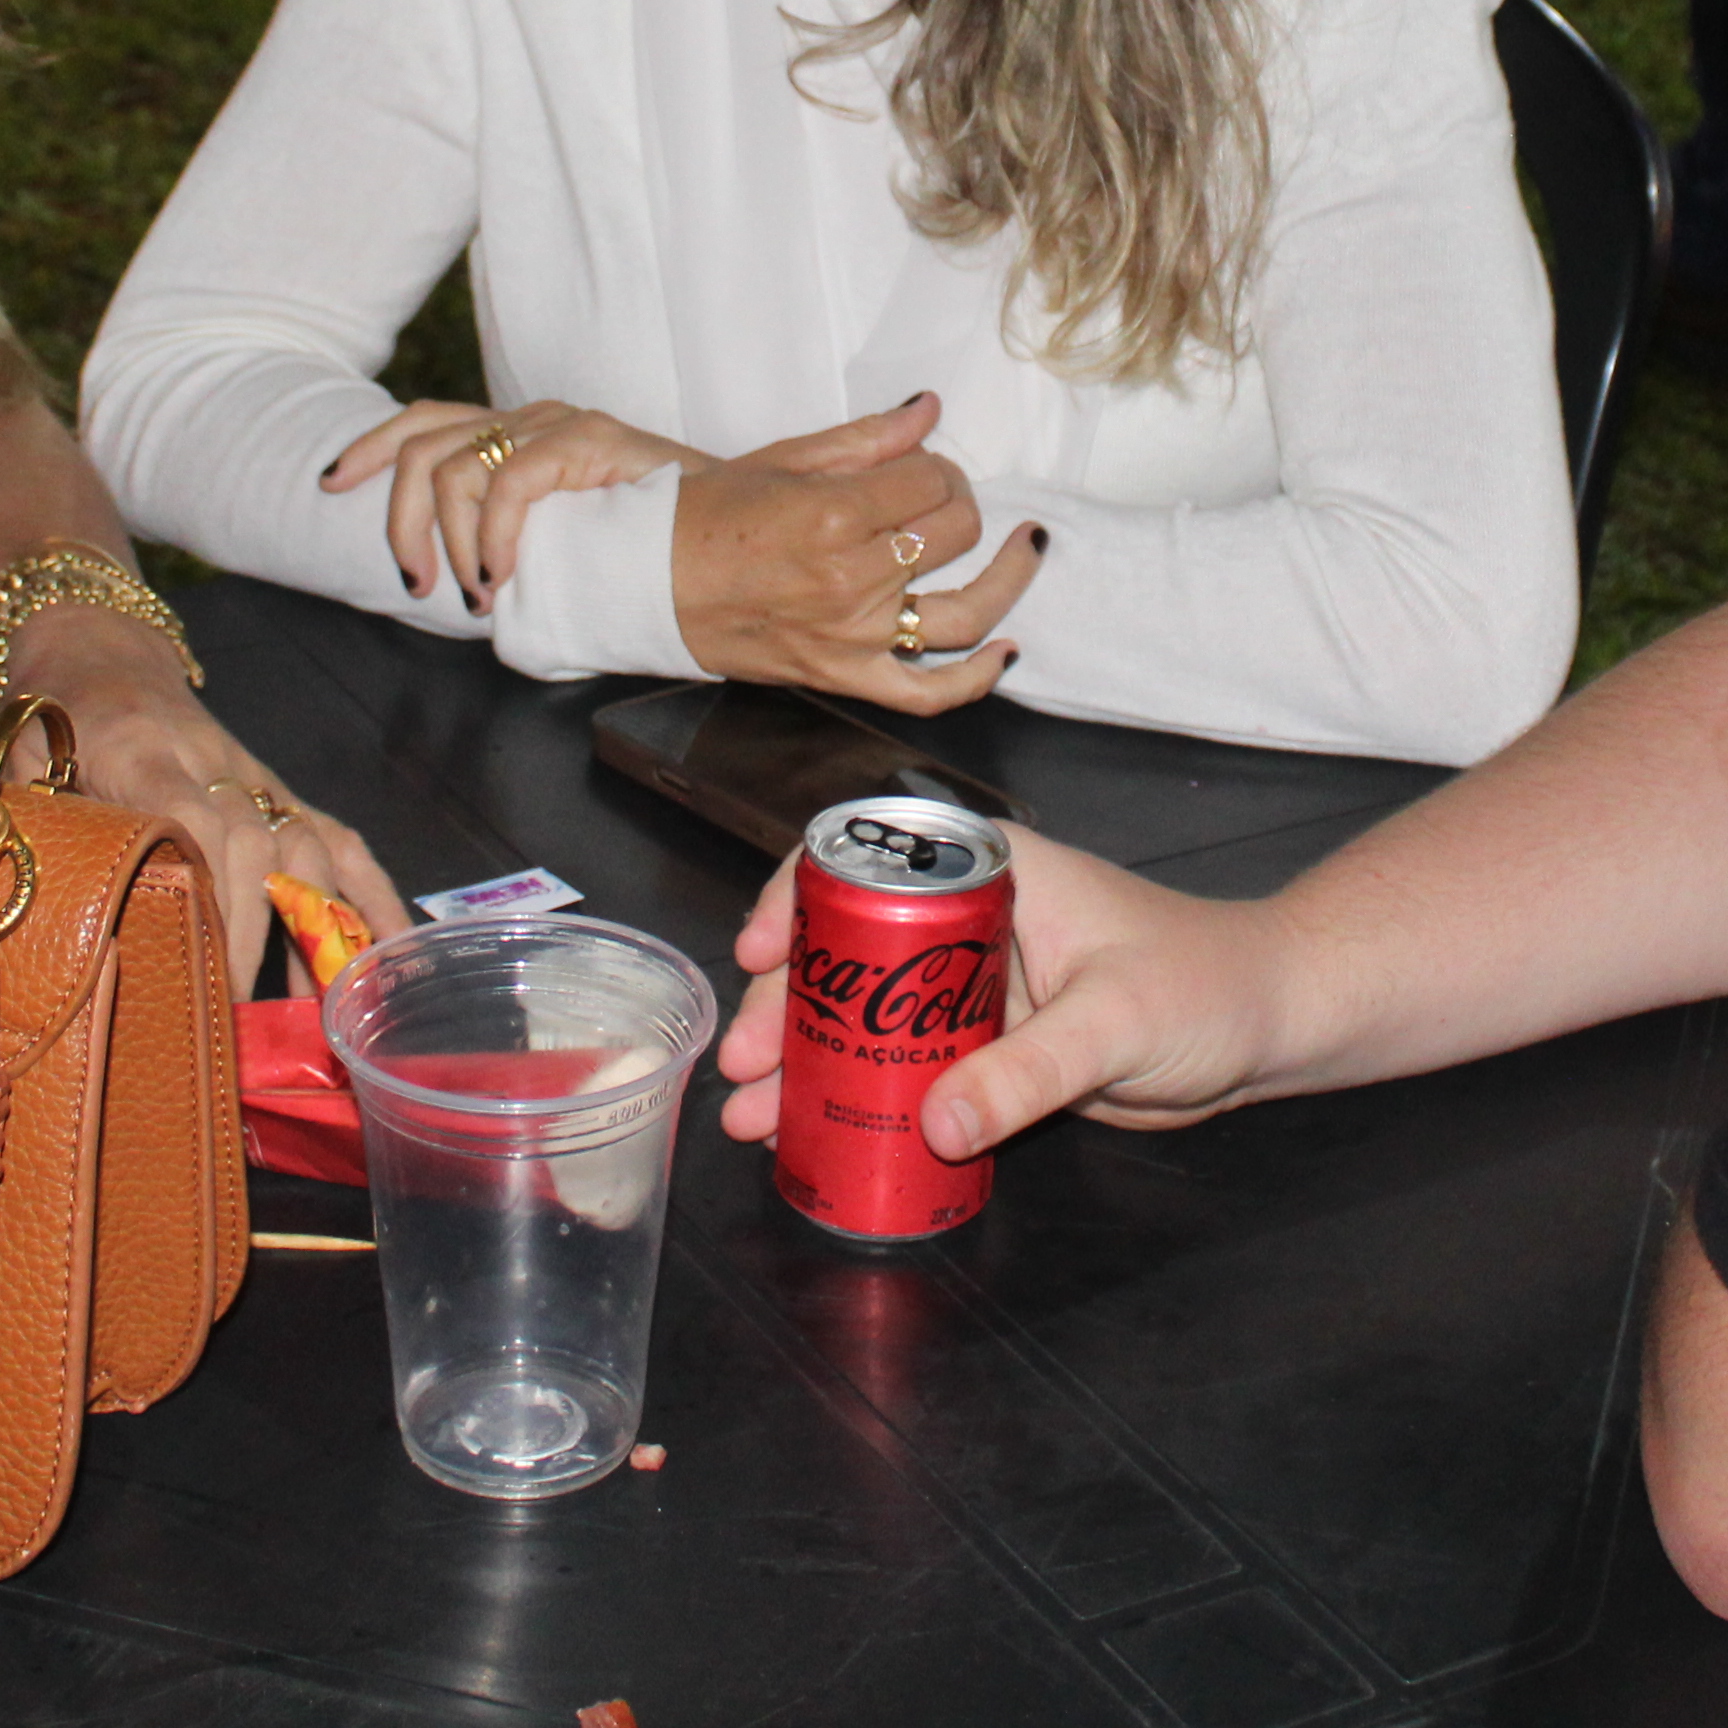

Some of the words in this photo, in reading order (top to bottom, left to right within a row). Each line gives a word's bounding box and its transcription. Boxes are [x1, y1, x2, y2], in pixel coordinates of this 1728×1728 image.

[789, 907, 1002, 1039] oca-Cola
[796, 1017, 845, 1053] ZERO
[855, 1045, 957, 1067] AÇÚCAR
